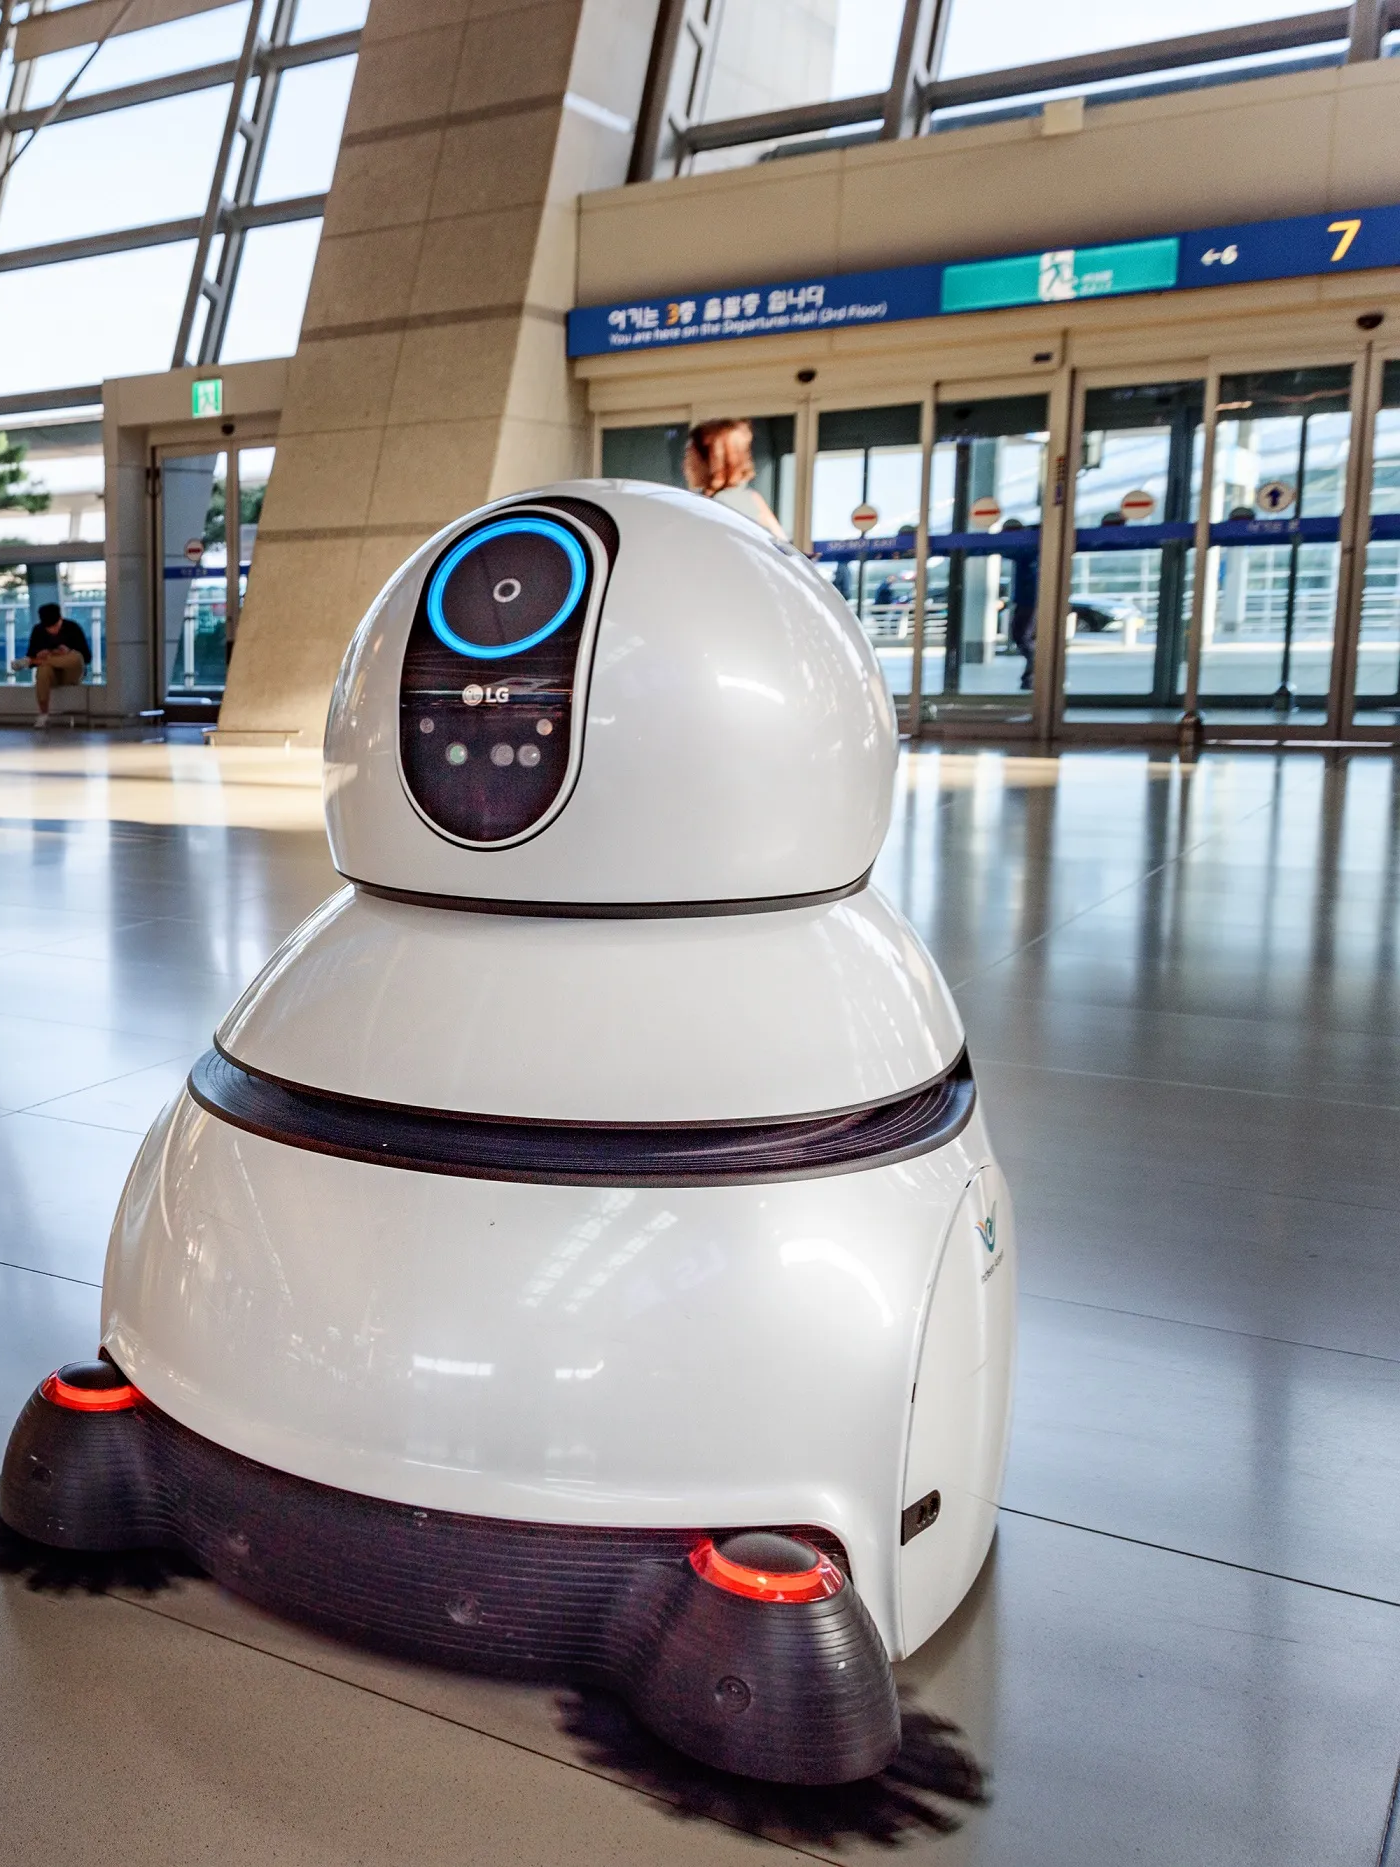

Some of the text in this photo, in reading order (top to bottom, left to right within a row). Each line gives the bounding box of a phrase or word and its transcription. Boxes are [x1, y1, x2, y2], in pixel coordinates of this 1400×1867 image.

[1327, 219, 1361, 262] 7
[1220, 244, 1238, 265] 6
[608, 306, 660, 331] 여기는
[767, 285, 825, 314] 입니다
[610, 330, 632, 346] You
[633, 330, 653, 344] are
[653, 327, 681, 342] here
[681, 325, 699, 338] on
[701, 322, 721, 337] the
[485, 687, 510, 703] LG
